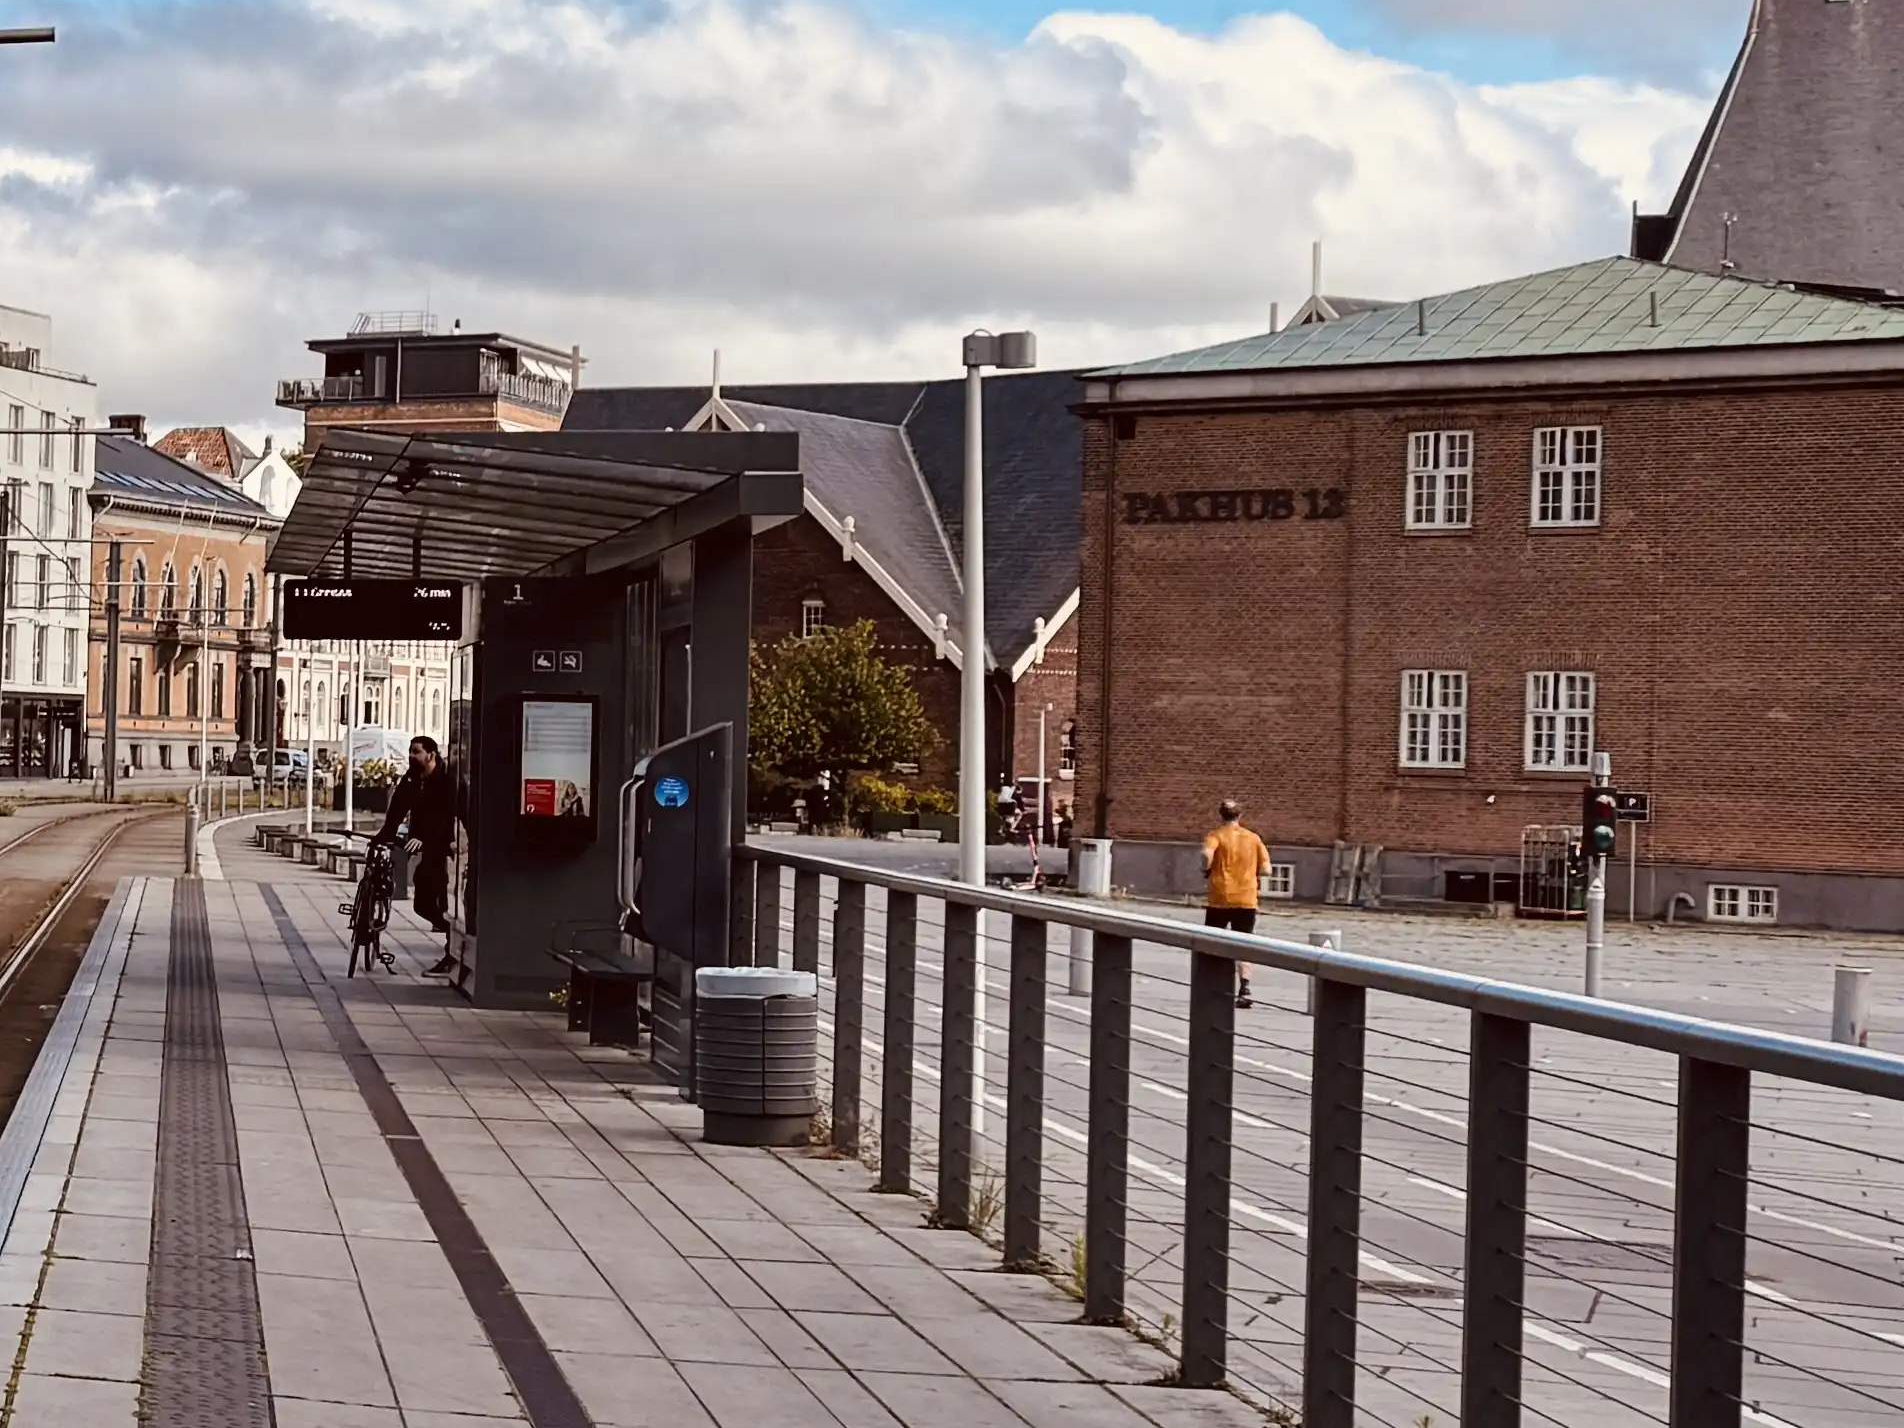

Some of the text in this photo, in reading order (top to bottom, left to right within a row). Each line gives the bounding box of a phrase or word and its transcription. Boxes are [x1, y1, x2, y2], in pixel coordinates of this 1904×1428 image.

[1124, 487, 1346, 524] PAKHUS 13
[512, 584, 524, 600] 1
[1628, 797, 1637, 807] P
